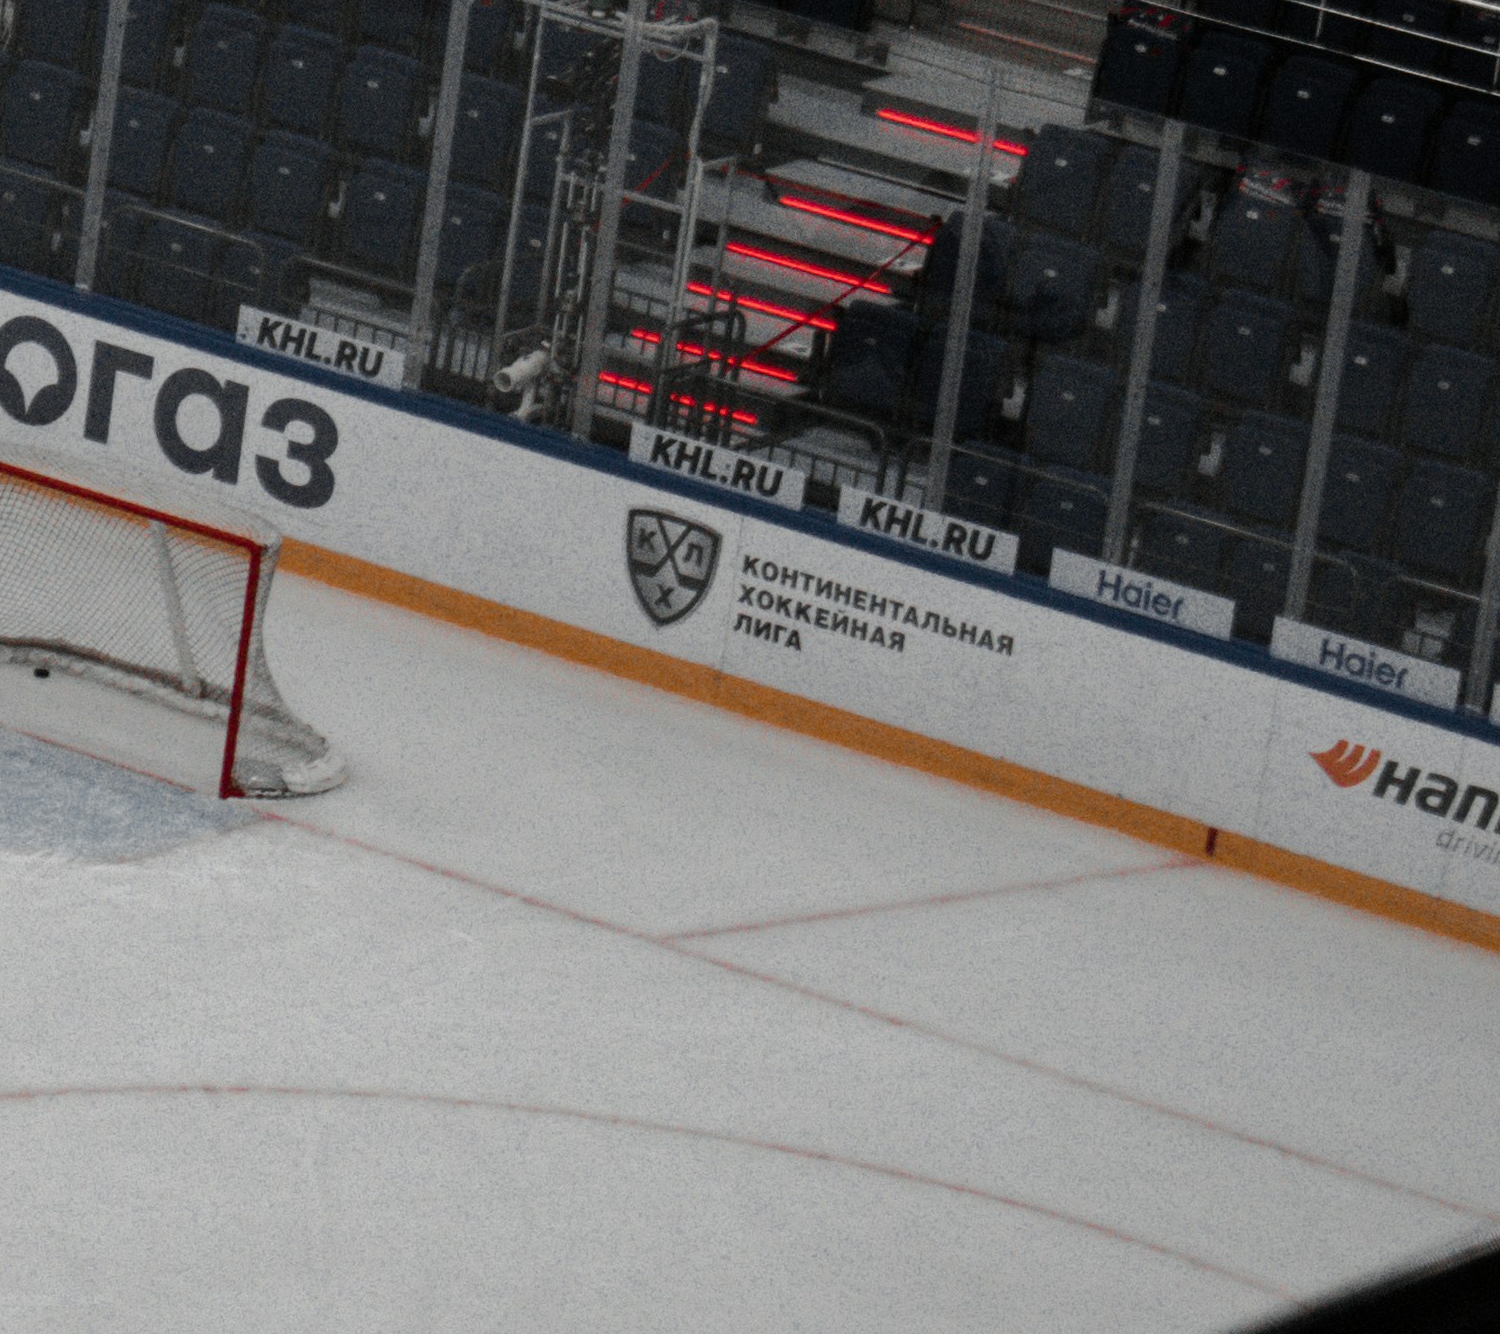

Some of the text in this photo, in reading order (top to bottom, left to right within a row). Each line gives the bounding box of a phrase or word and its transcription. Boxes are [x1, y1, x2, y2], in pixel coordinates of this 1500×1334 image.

[256, 316, 384, 378] KHL.RU
[651, 435, 784, 497] KHL.RU
[860, 498, 996, 563] KHL.RU
[738, 583, 907, 653] ХОККЕЙНАЯ
[743, 555, 1015, 656] КОНТИНЕНТАЛЬНАЯ
[1098, 569, 1188, 621] Haier
[733, 614, 804, 652] ЛИГА
[1320, 638, 1410, 691] Haier
[1372, 759, 1500, 835] Han
